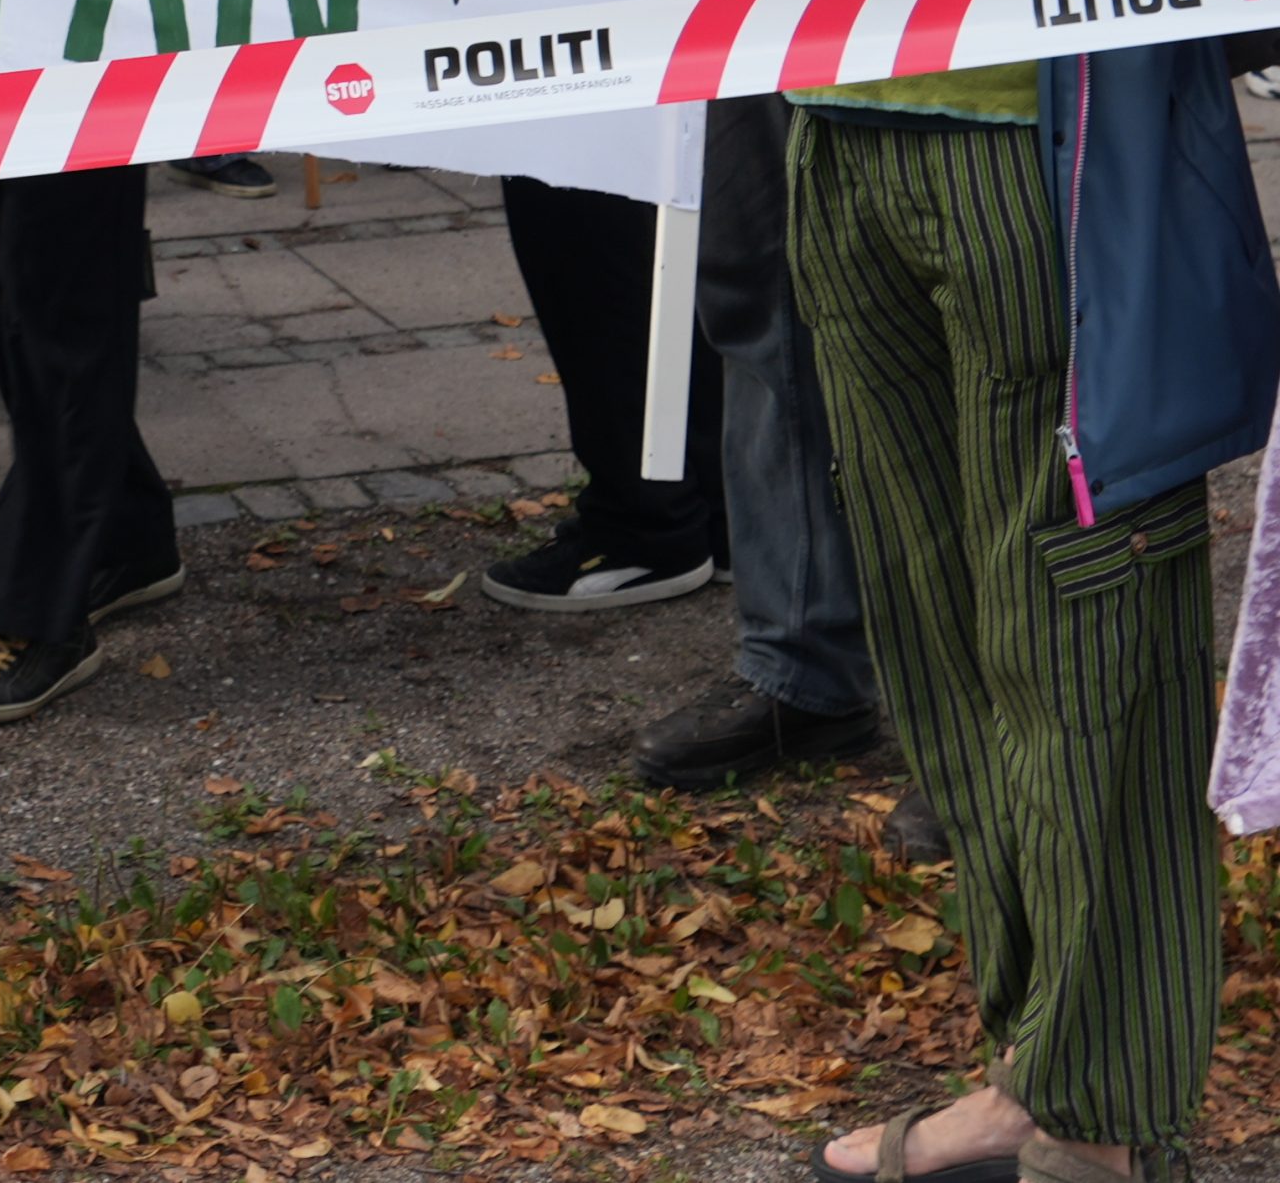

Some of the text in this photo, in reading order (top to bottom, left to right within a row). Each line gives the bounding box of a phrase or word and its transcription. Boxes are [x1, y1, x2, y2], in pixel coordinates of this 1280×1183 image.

[424, 28, 613, 91] POLITI
[326, 80, 372, 101] STOP
[467, 92, 492, 104] KAN
[494, 86, 549, 102] MEDFØRE
[550, 75, 632, 95] STRAFANSVAR
